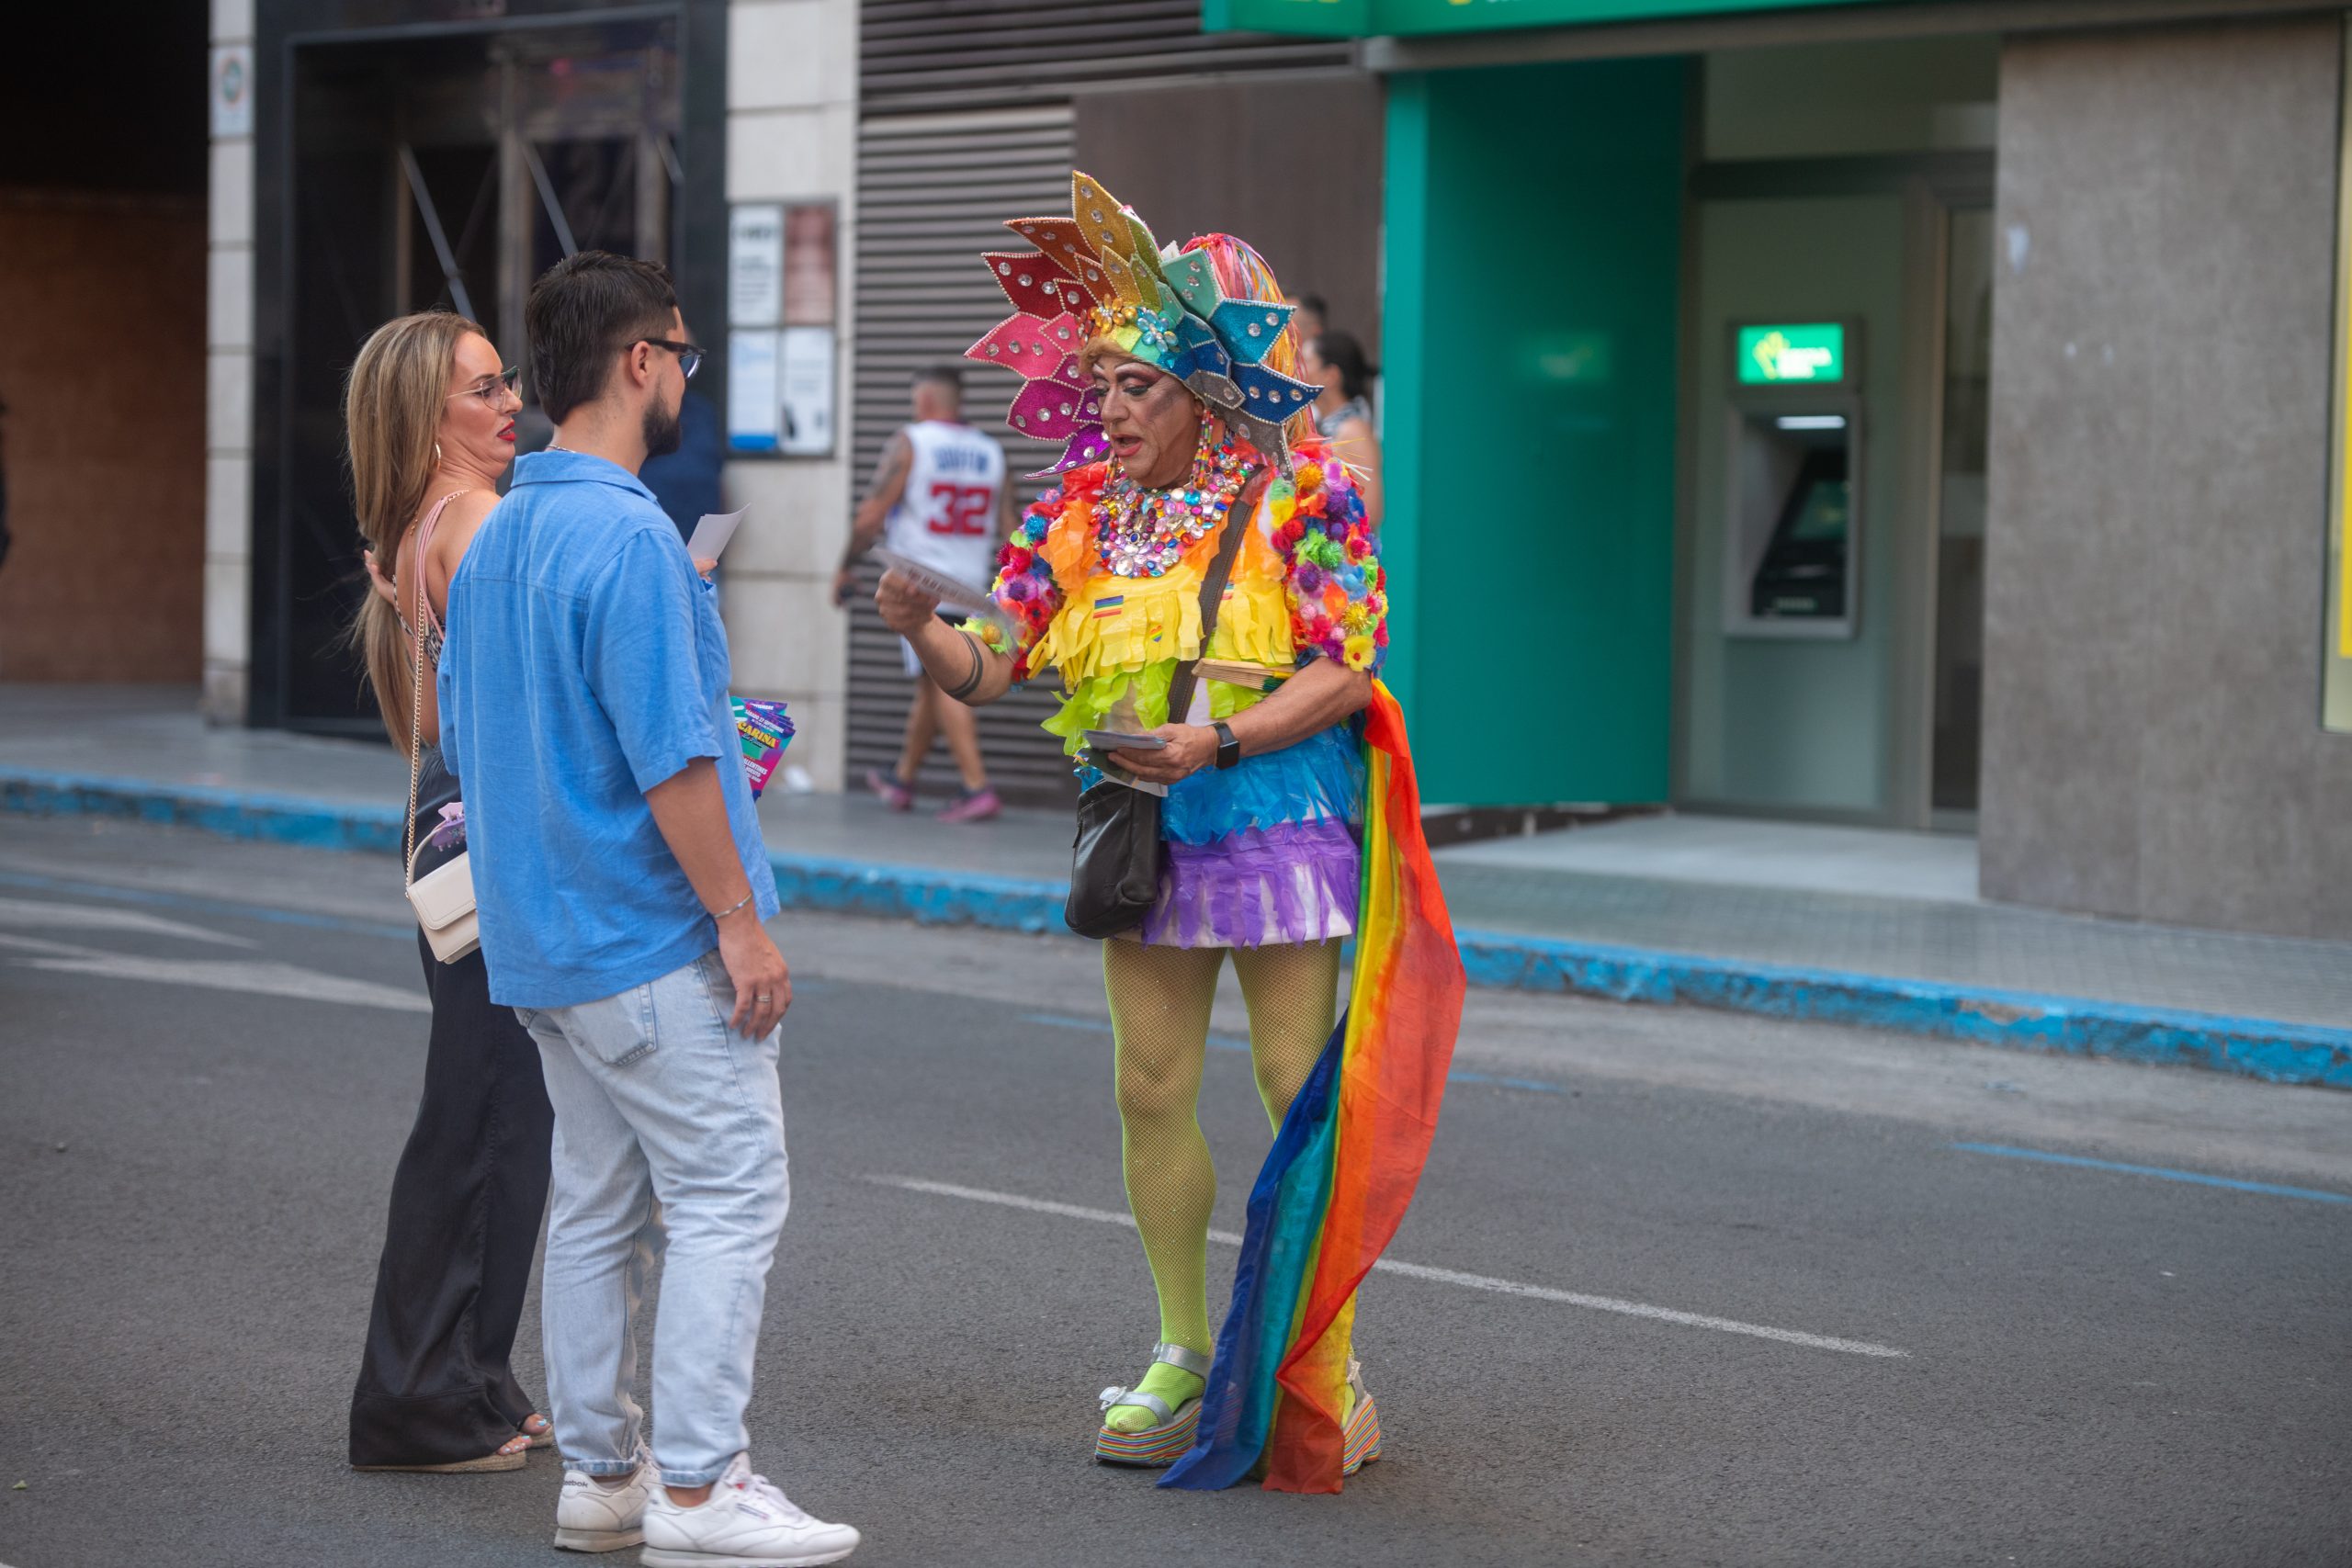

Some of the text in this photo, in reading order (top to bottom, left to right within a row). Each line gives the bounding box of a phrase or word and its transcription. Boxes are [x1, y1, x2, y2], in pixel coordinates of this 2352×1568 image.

[928, 484, 991, 535] 32
[738, 721, 776, 748] CARIÑA
[562, 1480, 588, 1488] eebok
